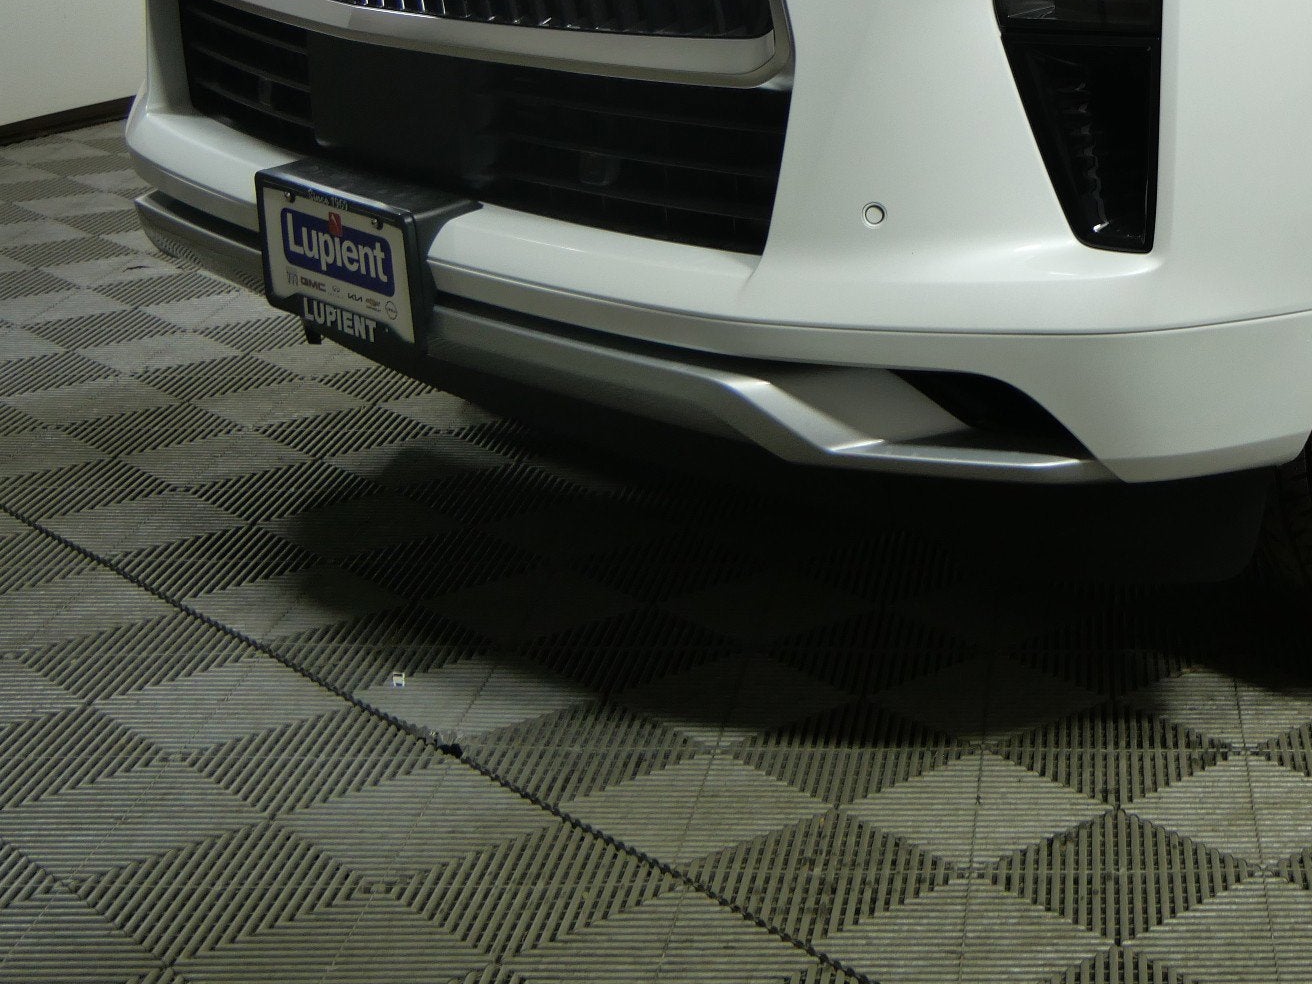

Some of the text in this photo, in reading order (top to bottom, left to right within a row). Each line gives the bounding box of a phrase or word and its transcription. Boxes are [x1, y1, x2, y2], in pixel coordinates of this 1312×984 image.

[286, 213, 388, 283] Lupient
[301, 277, 326, 293] GMC
[303, 296, 377, 343] LUPIENT
